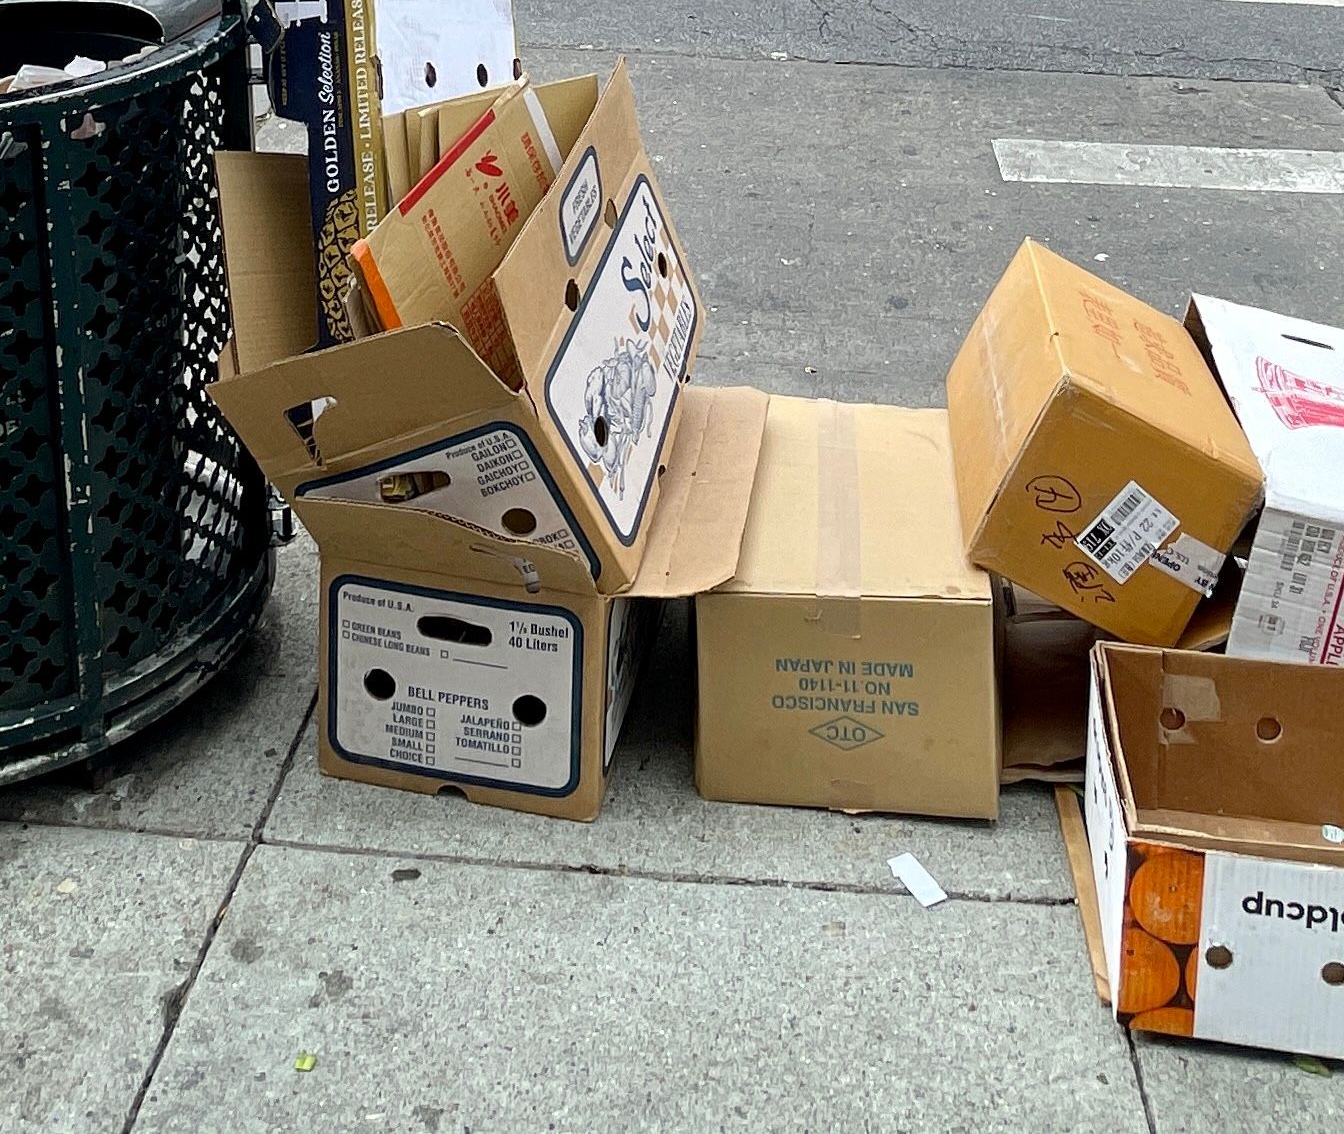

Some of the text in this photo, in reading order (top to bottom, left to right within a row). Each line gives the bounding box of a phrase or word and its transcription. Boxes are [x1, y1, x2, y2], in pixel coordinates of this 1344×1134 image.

[317, 30, 335, 105] Selection
[358, 72, 372, 141] LIMITED
[325, 107, 340, 194] GOLDEN
[362, 150, 379, 233] RELEASE
[620, 194, 658, 333] Select
[662, 300, 693, 380] VEGETABLES
[445, 444, 476, 460] Produce
[485, 433, 511, 448] U.S.A.
[471, 442, 507, 463] GAILON
[476, 453, 514, 473] DAIKON
[477, 464, 521, 486] GAICHOY
[480, 475, 527, 498] BOKCHOY
[342, 590, 376, 606] Produce
[387, 597, 414, 613] U.S.A.
[351, 622, 402, 640] GREEN BEANS
[530, 622, 570, 639] Bushel
[351, 632, 430, 656] CHINESE LONG BEANS
[509, 636, 558, 653] 40 Liters
[774, 658, 914, 678] MADE IN JAPAN
[391, 702, 424, 716] JUMBO
[408, 686, 489, 711] BELL PEPPERS
[772, 694, 920, 716] SAN FRANCISCO
[392, 713, 424, 728] LARGE
[385, 724, 424, 740] MEDIUM
[463, 726, 510, 743] SERRANO
[825, 725, 867, 742] OTC
[391, 737, 424, 752] SMALL
[456, 737, 510, 755] TOMATILLO
[389, 748, 424, 764] CHOICE
